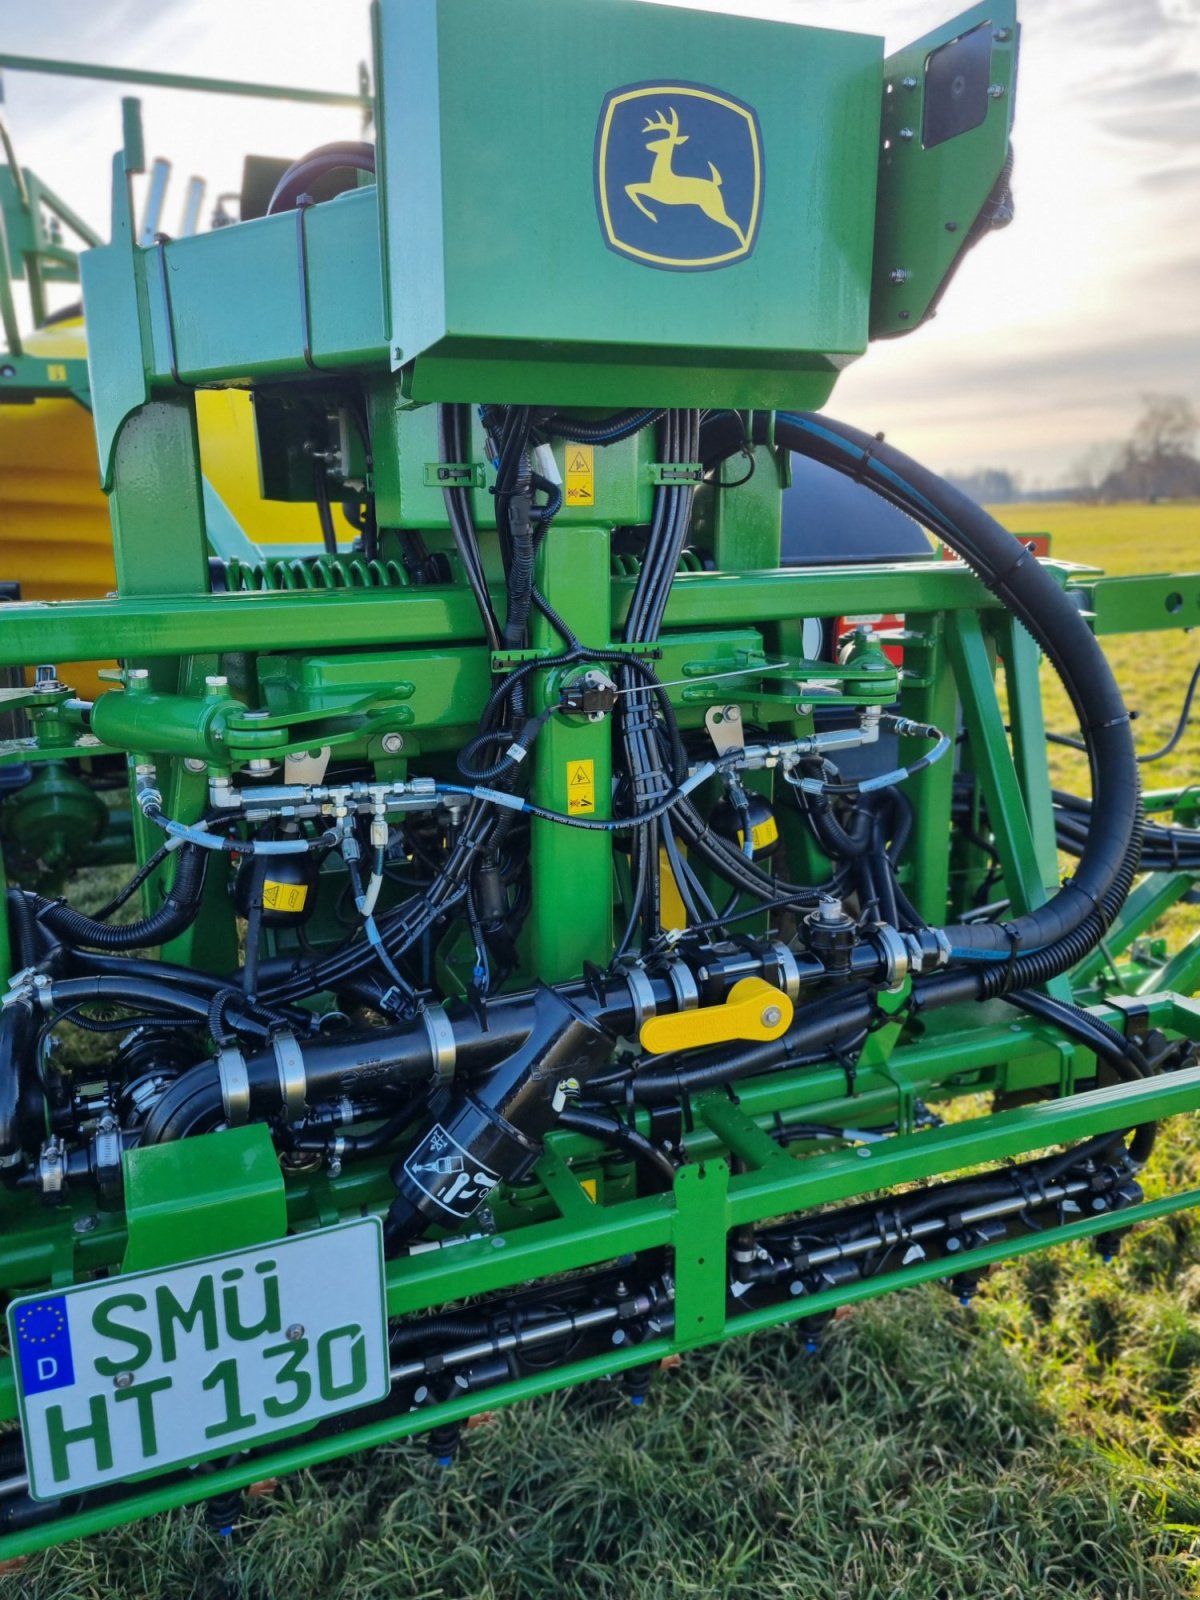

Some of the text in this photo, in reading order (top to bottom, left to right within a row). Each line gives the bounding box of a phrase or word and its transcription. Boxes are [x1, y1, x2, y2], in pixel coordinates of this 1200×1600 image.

[37, 1356, 58, 1381] D
[92, 1259, 282, 1376] SMÜ
[45, 1323, 367, 1483] HT 130
